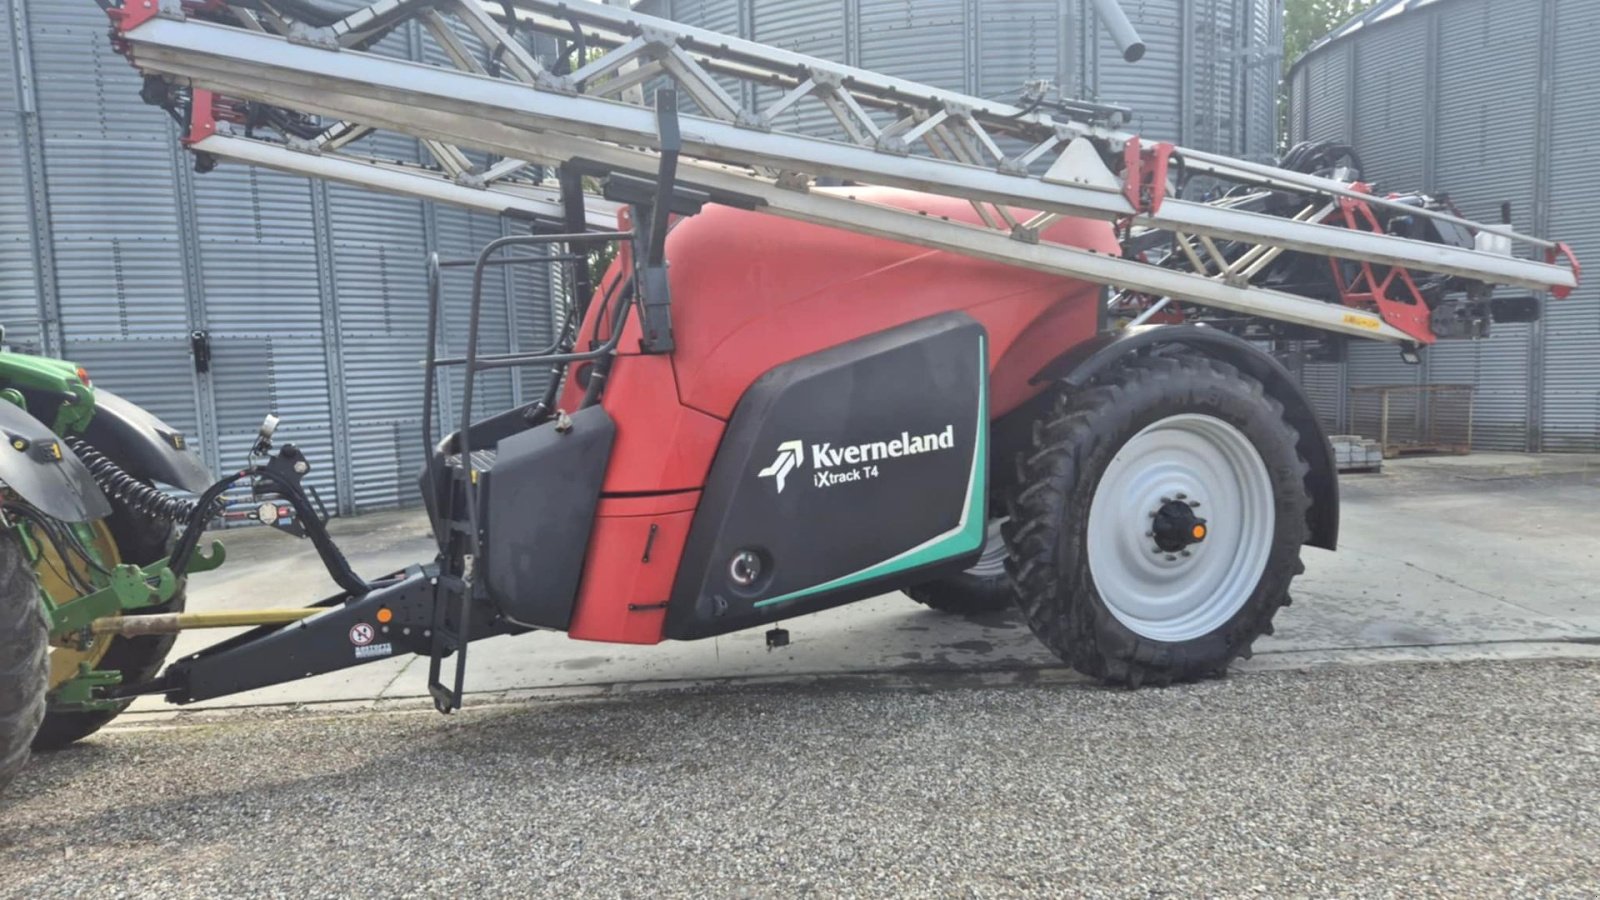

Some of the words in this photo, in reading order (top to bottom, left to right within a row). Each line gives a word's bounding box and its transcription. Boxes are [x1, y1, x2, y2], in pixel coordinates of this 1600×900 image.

[811, 424, 953, 469] Kverneland
[813, 469, 861, 488] iXtrack
[863, 465, 879, 479] T4
